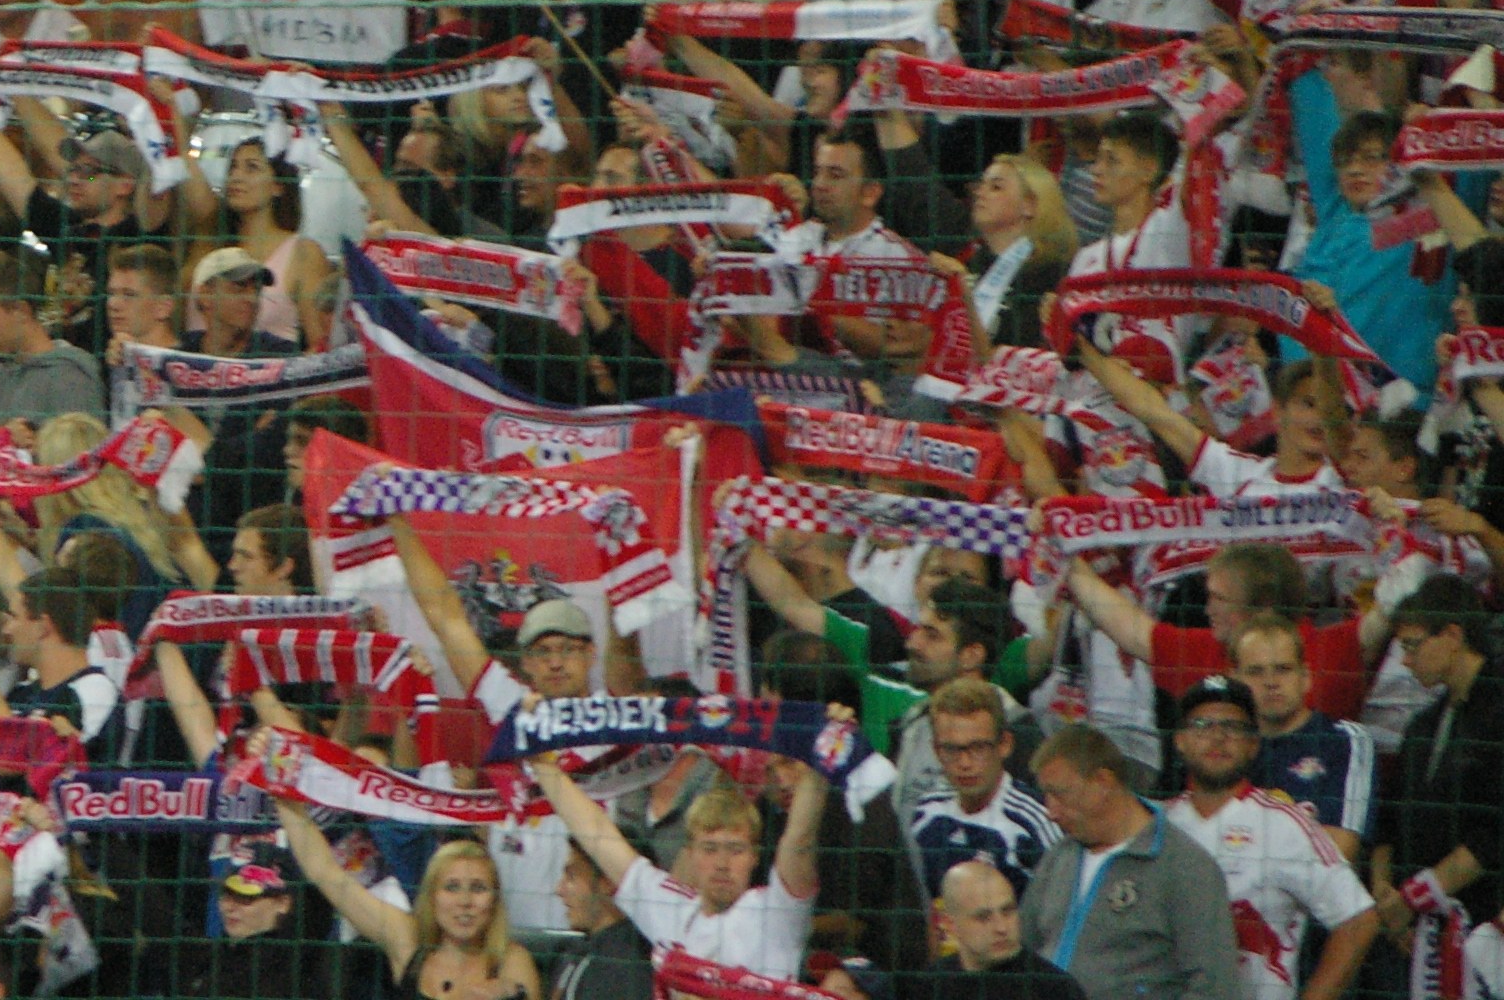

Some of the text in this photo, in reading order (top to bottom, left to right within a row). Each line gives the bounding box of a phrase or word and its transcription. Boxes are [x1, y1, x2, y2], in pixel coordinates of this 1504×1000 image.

[786, 408, 982, 479] Red Bull Arena
[1049, 503, 1123, 538] Red
[1131, 497, 1204, 532] Bull
[164, 603, 211, 623] Red
[212, 599, 253, 618] Bull
[515, 696, 668, 750] MEISTER
[63, 780, 131, 818] Red
[137, 779, 211, 818] Bull
